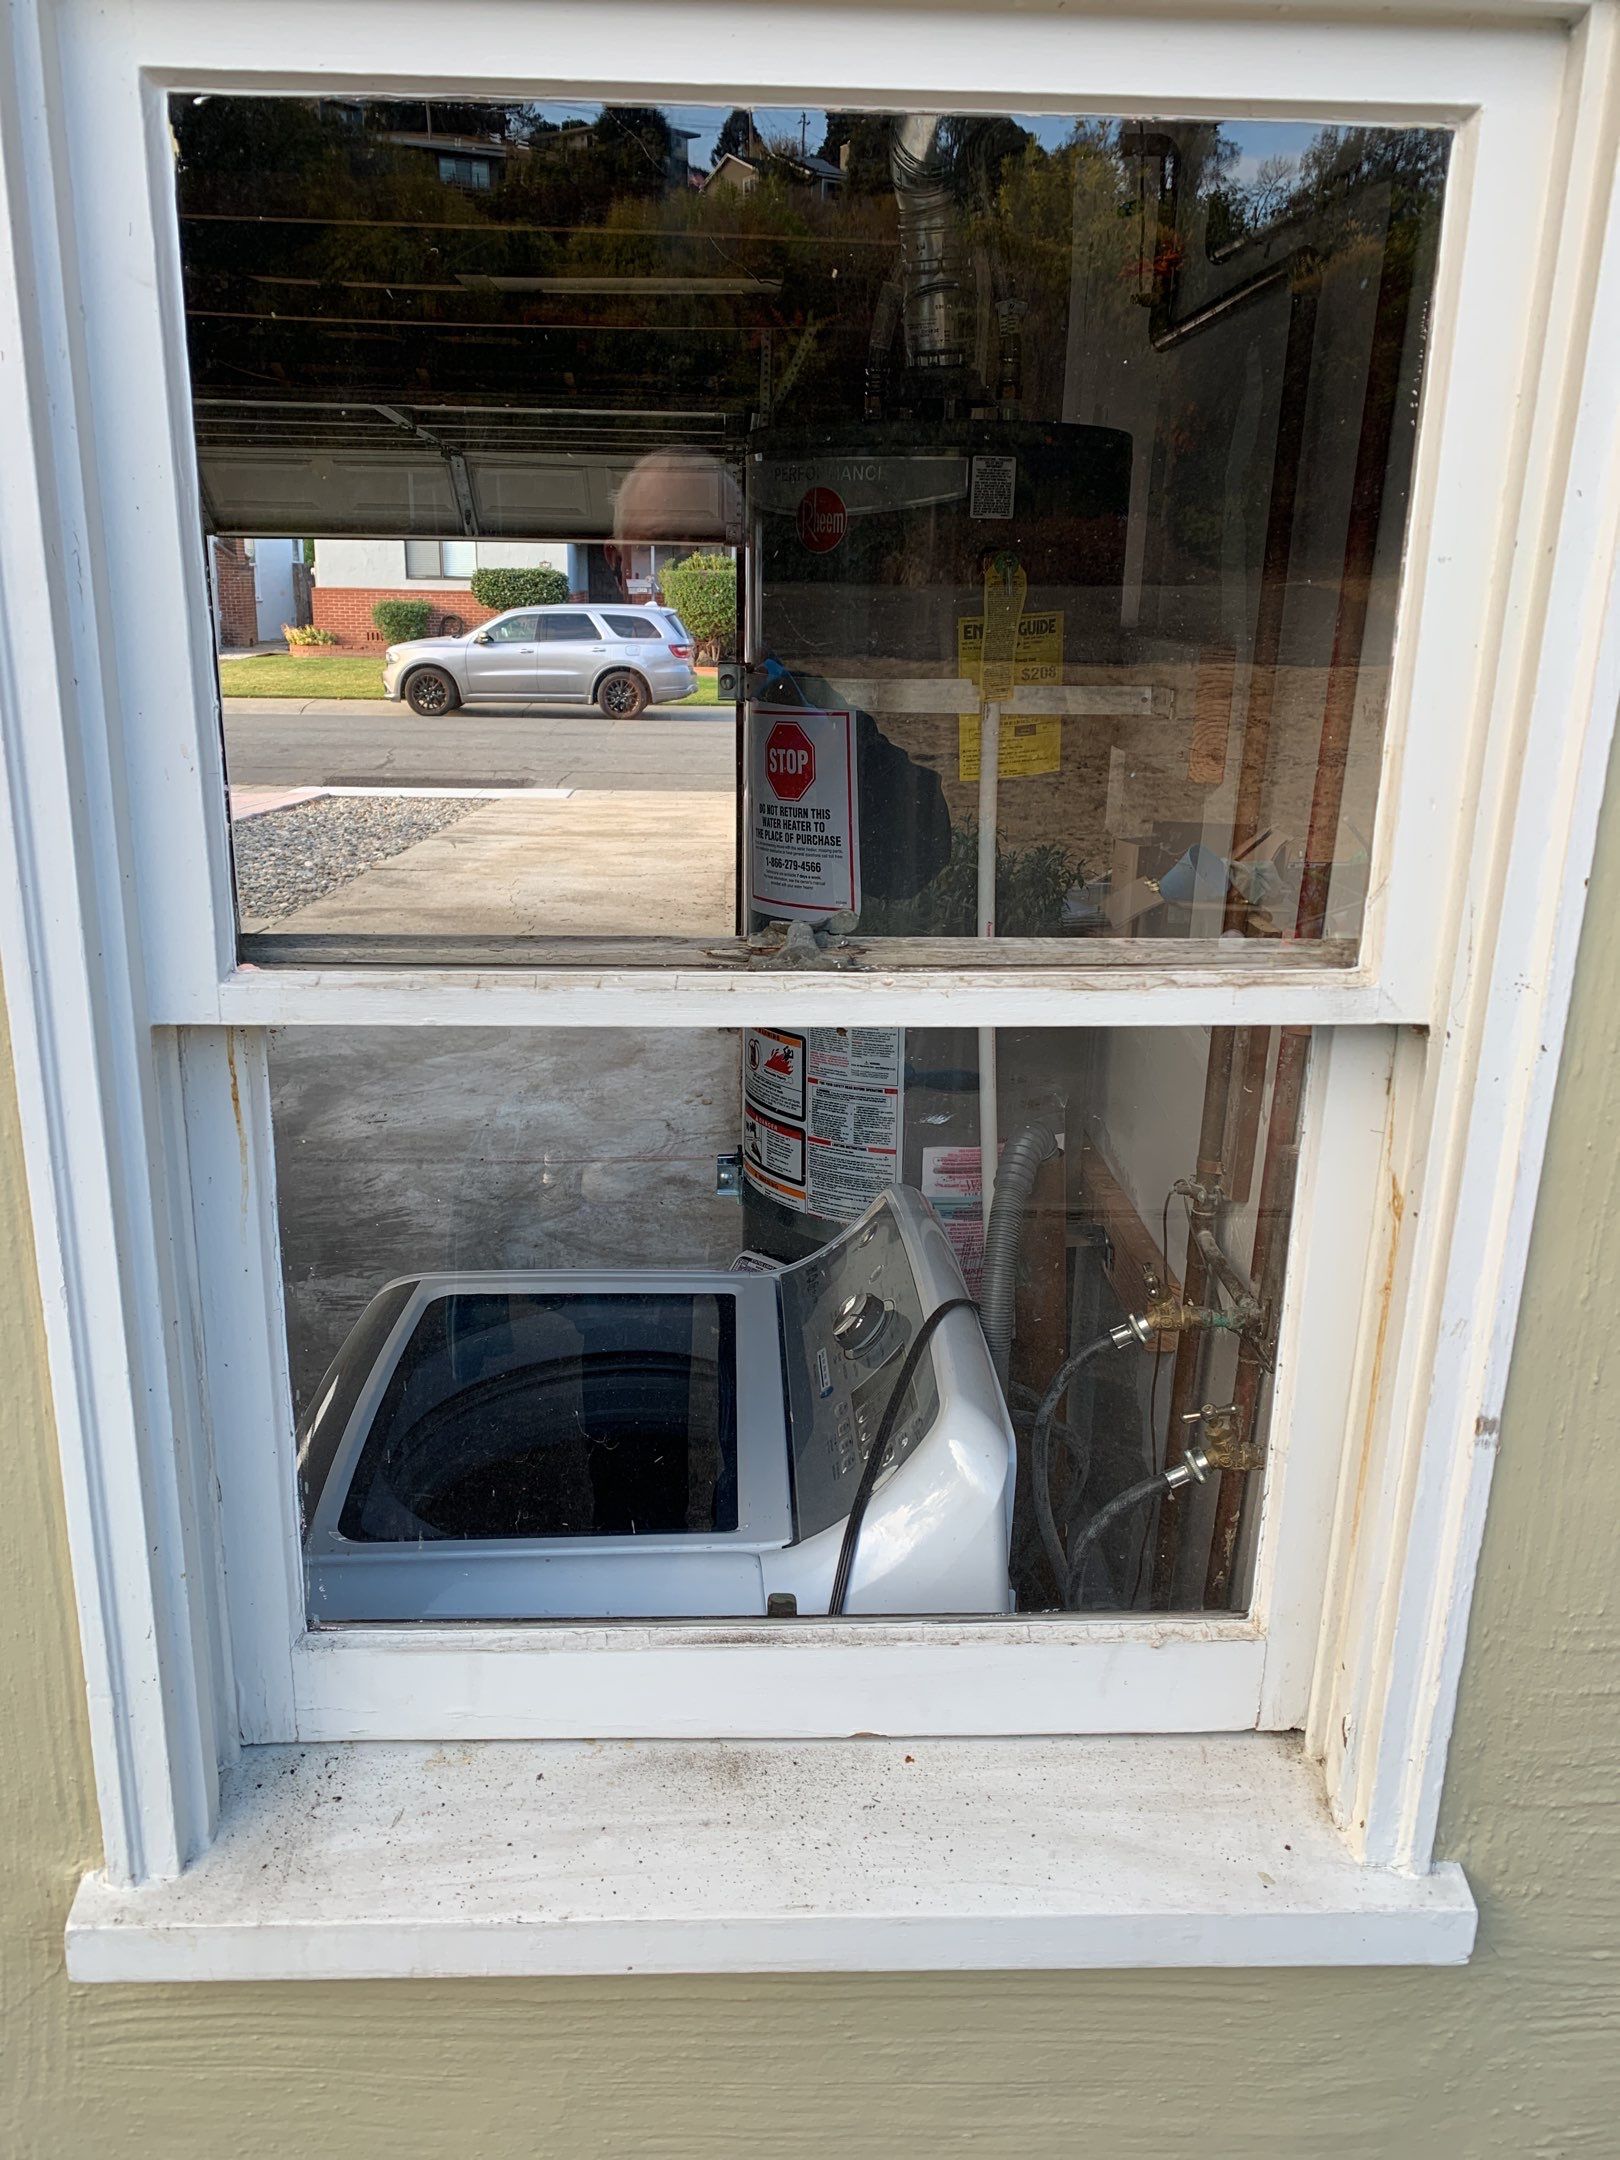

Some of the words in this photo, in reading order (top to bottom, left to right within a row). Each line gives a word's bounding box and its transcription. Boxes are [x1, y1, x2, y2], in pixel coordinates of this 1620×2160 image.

[802, 487, 844, 542] Rheem
[1018, 618, 1056, 636] GUIDE
[769, 748, 809, 775] STOP
[759, 803, 766, 815] DO
[767, 804, 778, 817] NOT
[779, 805, 808, 820] RETURN
[810, 807, 831, 820] THIS
[762, 815, 781, 830] WATER
[782, 818, 812, 833] HEATER
[813, 820, 826, 833] TO
[755, 827, 764, 840] THE
[764, 828, 783, 843] PLACE
[784, 831, 795, 844] OF
[796, 832, 842, 847] PURCHASE
[765, 856, 822, 873] 1-866-279-4566
